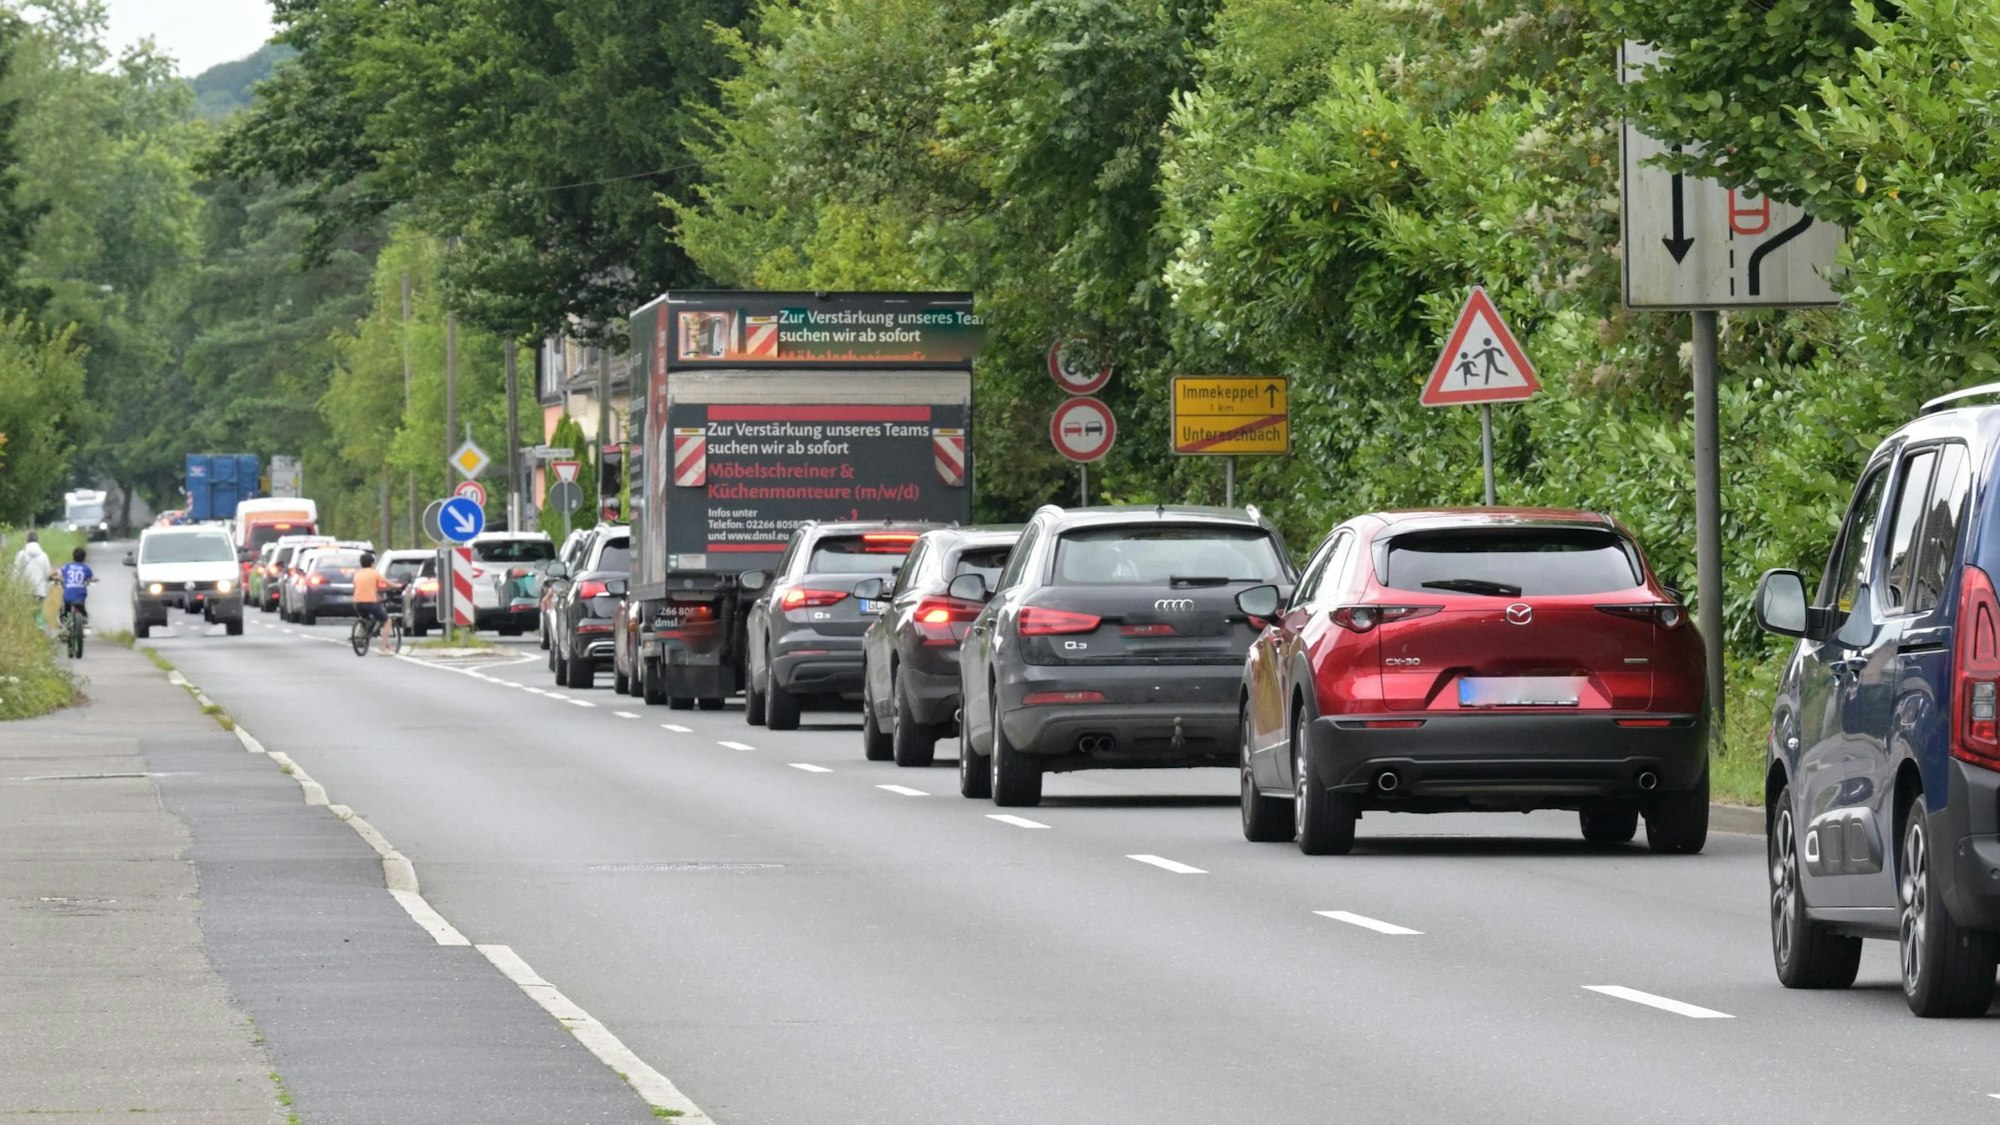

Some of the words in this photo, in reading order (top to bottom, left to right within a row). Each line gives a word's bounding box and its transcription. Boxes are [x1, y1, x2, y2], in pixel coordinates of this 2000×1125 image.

[779, 310, 804, 324] Zur
[807, 310, 894, 326] Verstärkung
[899, 311, 953, 324] unseres
[780, 329, 829, 342] suchen
[832, 329, 855, 342] wir
[859, 329, 876, 342] ab
[879, 328, 921, 342] sofort
[1183, 384, 1259, 402] Immekeppel
[1210, 403, 1215, 412] 1
[1218, 403, 1234, 412] km
[707, 422, 732, 436] Zur
[735, 421, 822, 438] Verstärkung
[826, 423, 881, 437] unseres
[884, 423, 929, 437] Teams
[1183, 426, 1280, 441] Untereschbach
[707, 441, 758, 454] suchen
[761, 441, 784, 454] wir
[786, 441, 805, 454] ab
[807, 440, 849, 454] sofort
[708, 462, 836, 478] Möbelschreiner
[840, 463, 854, 478] &
[708, 482, 850, 499] Küchenmonteure
[854, 483, 919, 502] (m/w/d)
[708, 507, 730, 517] Infos
[732, 509, 758, 517] unter
[708, 519, 744, 529] Telefon:
[746, 520, 774, 529] 02266
[708, 531, 726, 540] und
[728, 531, 789, 540] www.dmsl.eu
[67, 570, 85, 584] 30
[814, 611, 831, 619] Q3
[1064, 640, 1088, 650] Q3
[1385, 657, 1421, 666] CX-30
